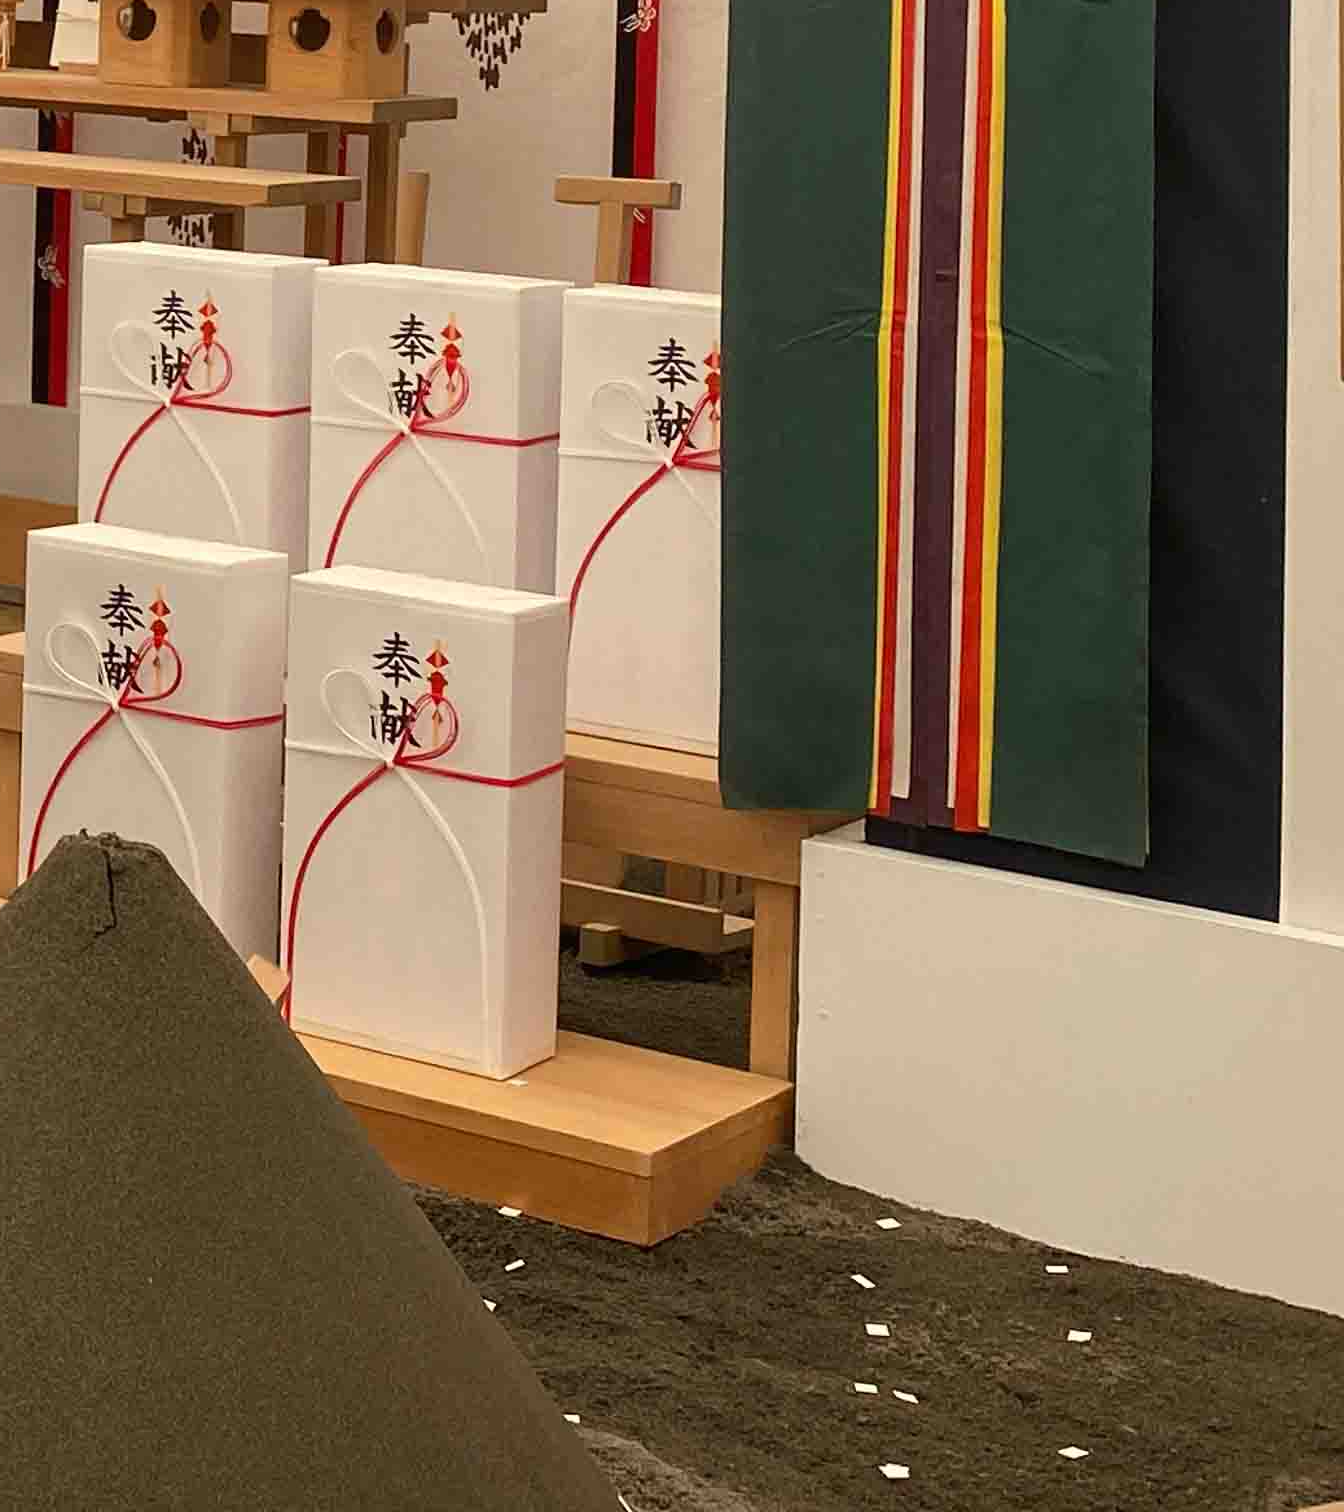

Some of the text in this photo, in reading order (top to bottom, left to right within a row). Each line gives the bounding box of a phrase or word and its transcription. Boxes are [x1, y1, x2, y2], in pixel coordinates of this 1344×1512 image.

[151, 290, 195, 391] 奉献
[389, 313, 436, 418] 奉献
[646, 338, 698, 449] 奉献
[98, 583, 146, 694] 奉献
[370, 631, 421, 749] 奉献
